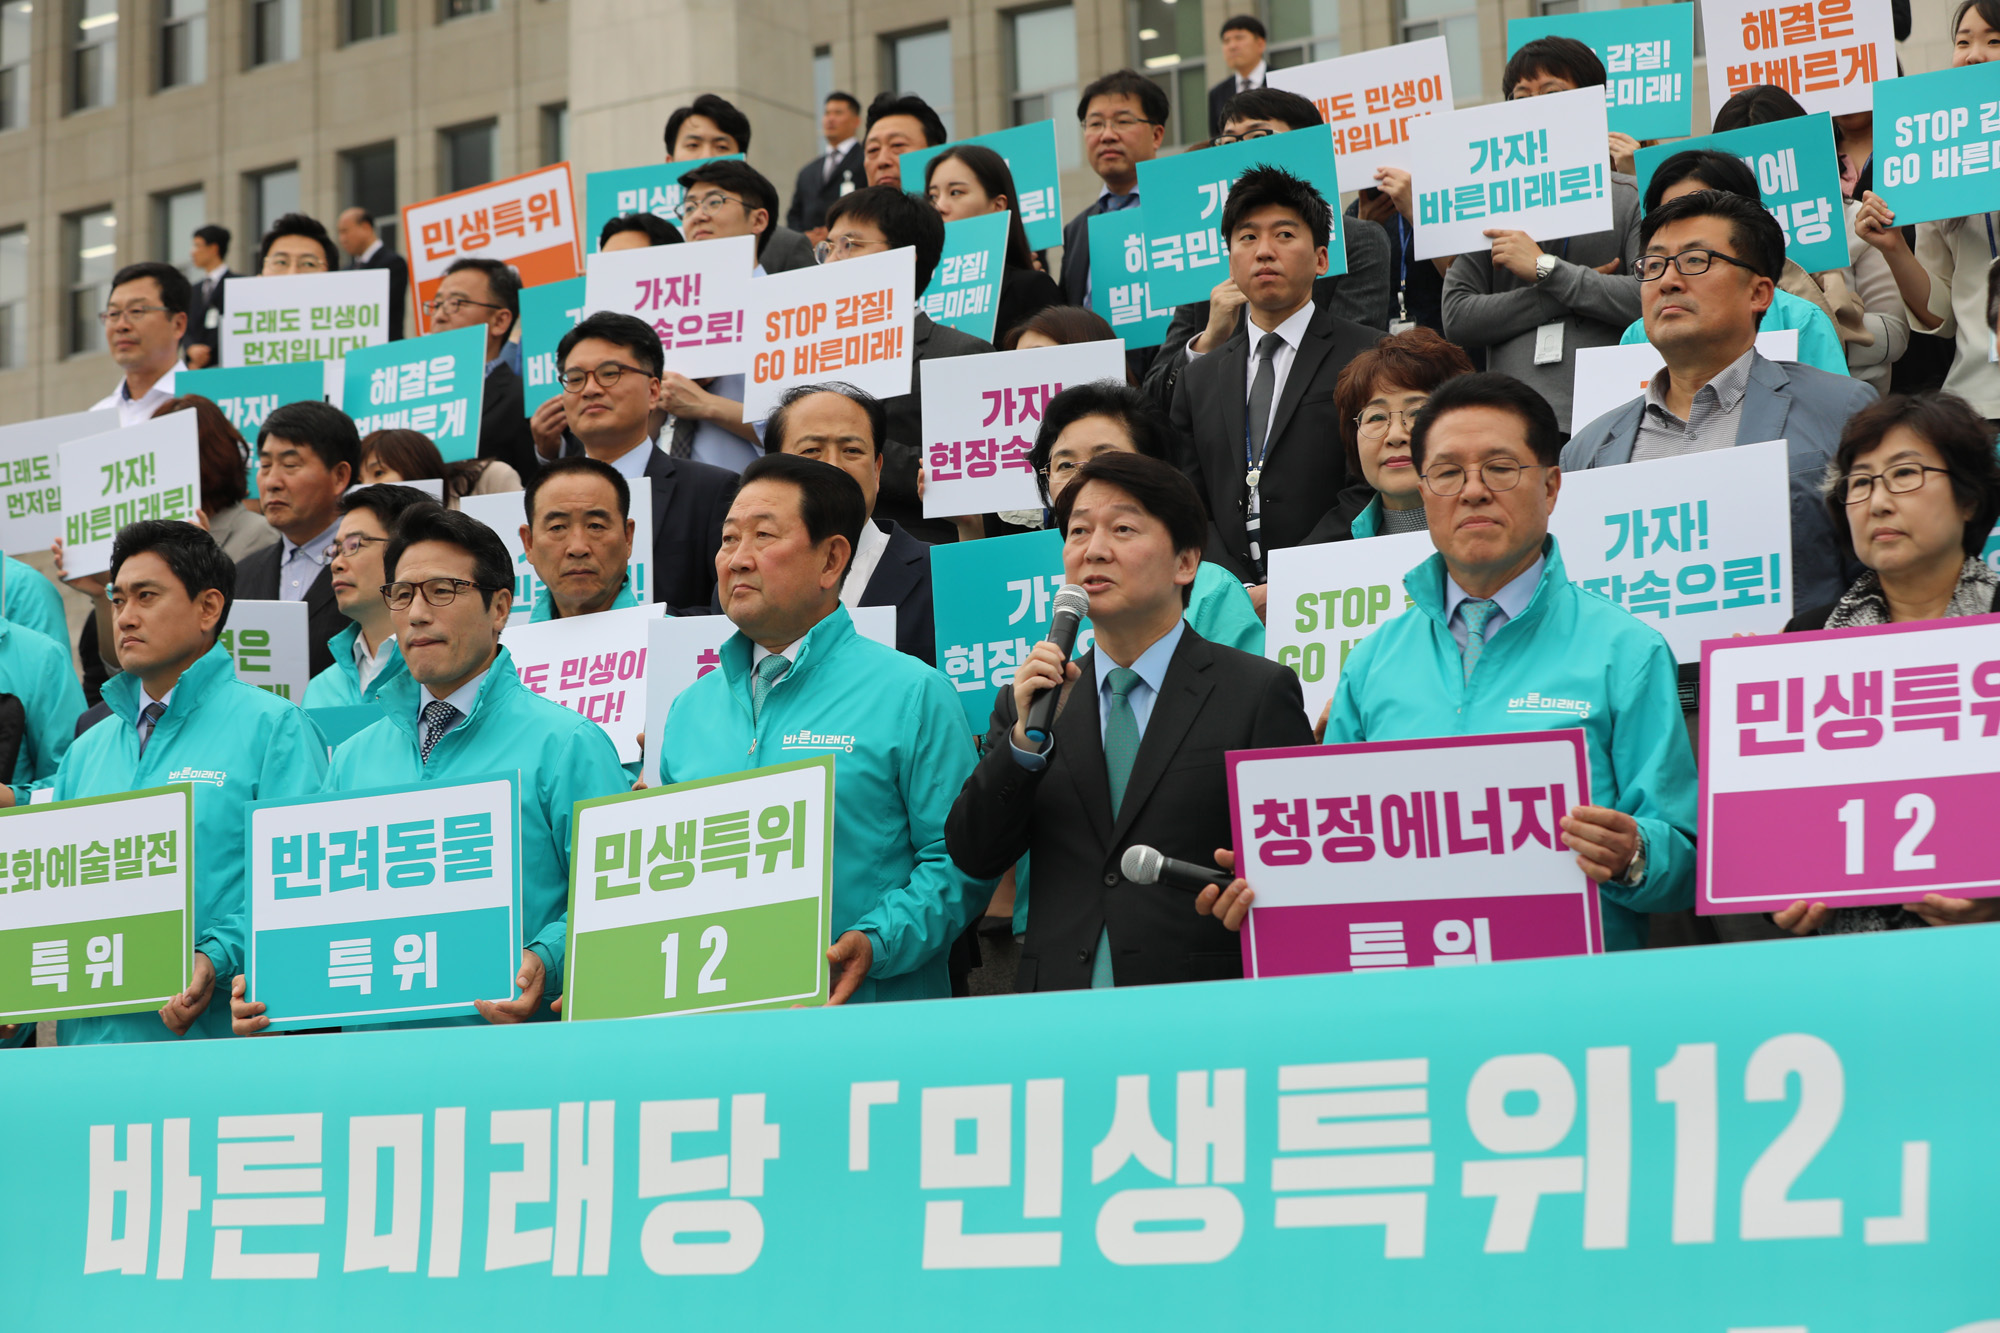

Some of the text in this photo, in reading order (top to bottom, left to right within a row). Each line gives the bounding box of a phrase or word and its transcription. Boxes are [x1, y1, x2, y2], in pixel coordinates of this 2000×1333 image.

[1741, 0, 1854, 52] 해결은
[1364, 75, 1443, 112] 민생이
[1469, 129, 1549, 175] 가자!
[1895, 107, 1969, 148] STOP
[1883, 139, 2000, 188] GO 바른
[1418, 164, 1604, 227] 바른미래로!
[422, 188, 562, 262] 민생특위
[634, 273, 702, 312] 가자!
[765, 288, 894, 343] STOP 갑질!
[232, 303, 380, 335] 그래도 민생이
[370, 353, 456, 406] 해결은
[753, 326, 903, 385] GO 바른미래!
[100, 452, 156, 498] 가자!
[1604, 500, 1708, 562] 가자!
[1295, 584, 1391, 633] STOP
[559, 647, 646, 691] 민생이
[1277, 642, 1326, 683] GO
[1507, 692, 1592, 719] 바른미래당
[782, 729, 856, 753] 바른미래당
[168, 766, 227, 787] 바른미래당
[1252, 783, 1570, 867] 청정에너지
[271, 811, 494, 900] 반려동물
[594, 799, 806, 901] 민생특위
[84, 1033, 1930, 1280] 바른미래당 「민생특위12」
